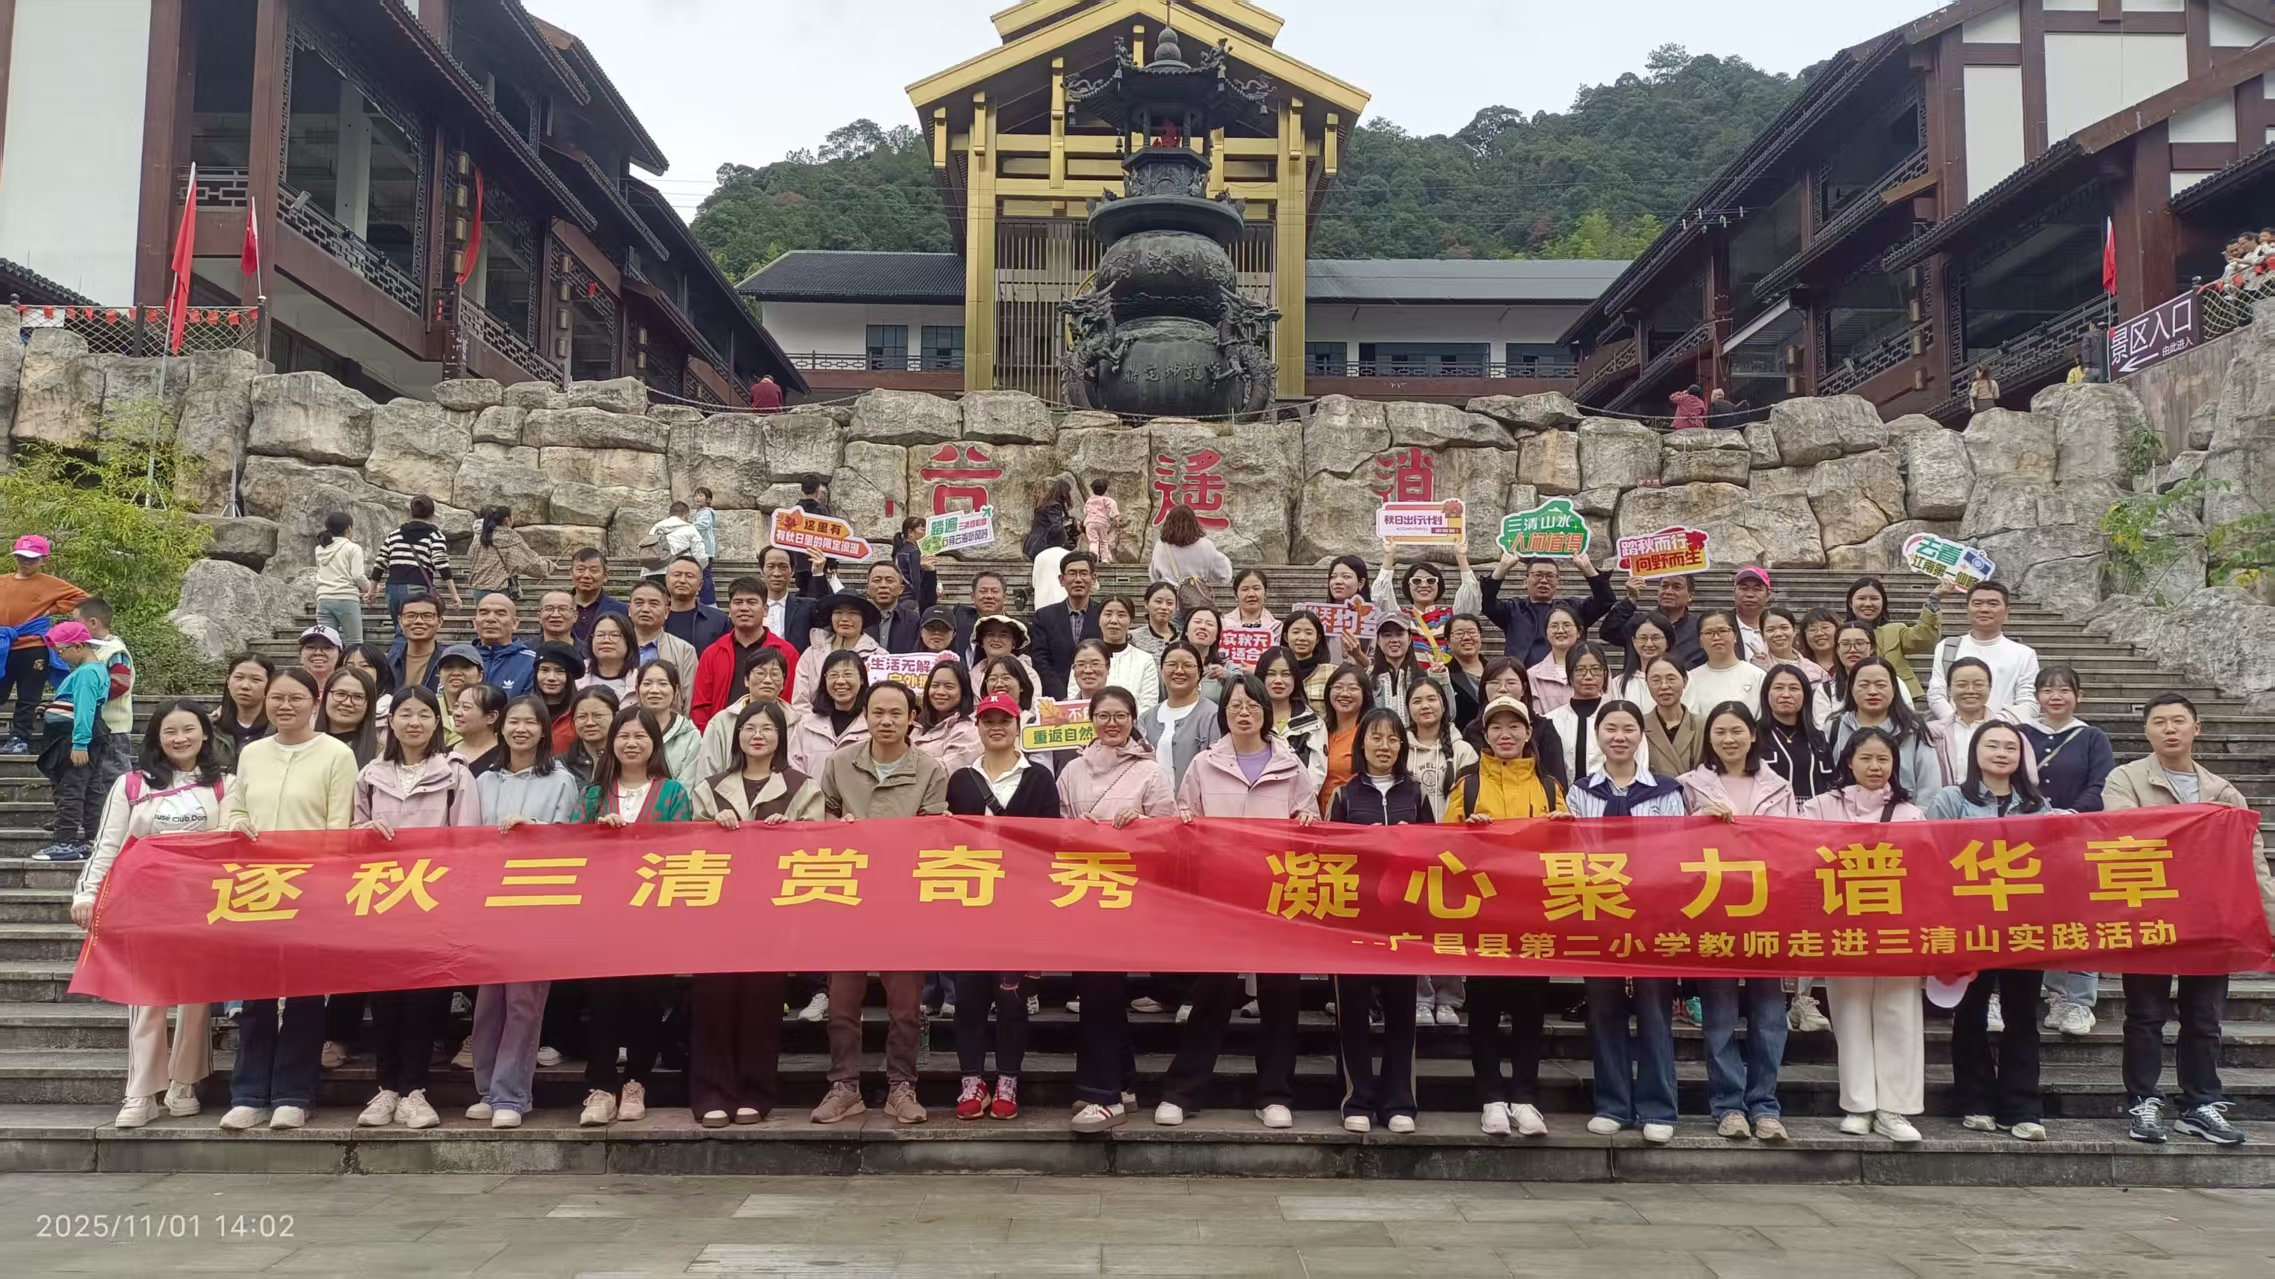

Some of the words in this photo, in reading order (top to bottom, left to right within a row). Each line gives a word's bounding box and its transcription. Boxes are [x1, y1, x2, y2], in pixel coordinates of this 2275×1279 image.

[2110, 298, 2192, 366] 景区入口
[2162, 336, 2194, 357] 由此进入
[803, 518, 843, 535] 这里有
[1384, 514, 1442, 526] 秋日出行计划
[1507, 514, 1572, 533] 三清山水
[1510, 532, 1585, 553] 人间值得
[1620, 532, 1688, 557] 踏秋而行
[1916, 536, 1964, 567] 去看
[1635, 550, 1703, 573] 向野而生
[1217, 646, 1268, 662] 适合
[1033, 726, 1094, 745] 重返自然
[207, 844, 1140, 925] 逐秋三清赏奇秀
[1267, 835, 2180, 923] 凝心聚力谱华章
